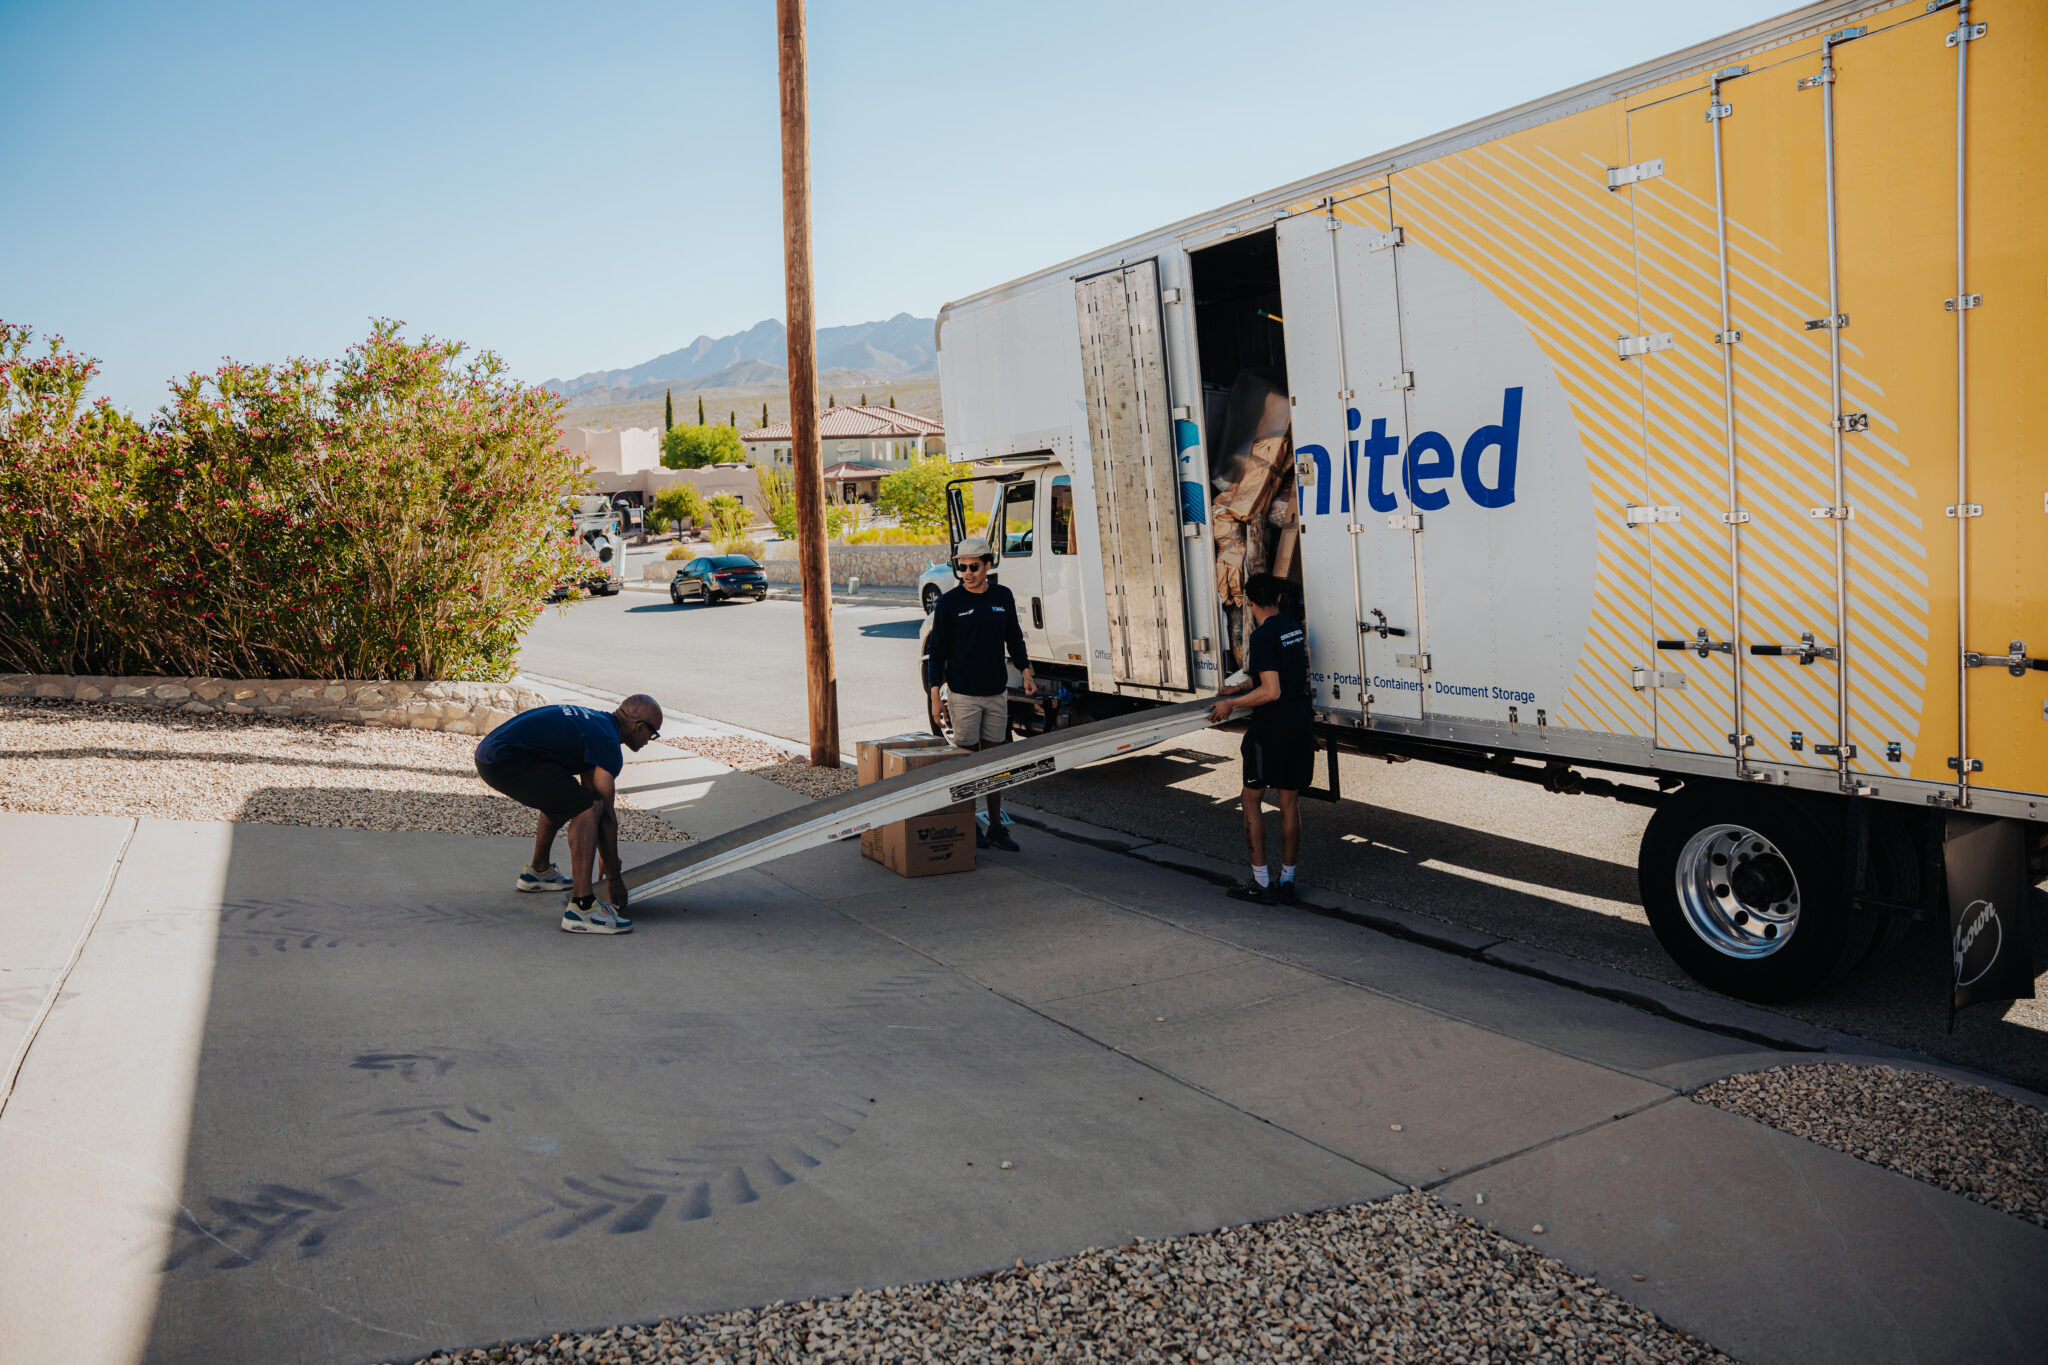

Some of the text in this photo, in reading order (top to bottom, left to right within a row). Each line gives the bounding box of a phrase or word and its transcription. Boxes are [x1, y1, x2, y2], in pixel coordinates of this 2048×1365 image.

[1333, 672, 1371, 687] Portabe
[1373, 675, 1425, 692] Containers
[1435, 681, 1489, 698] Document
[1492, 686, 1535, 704] Storage
